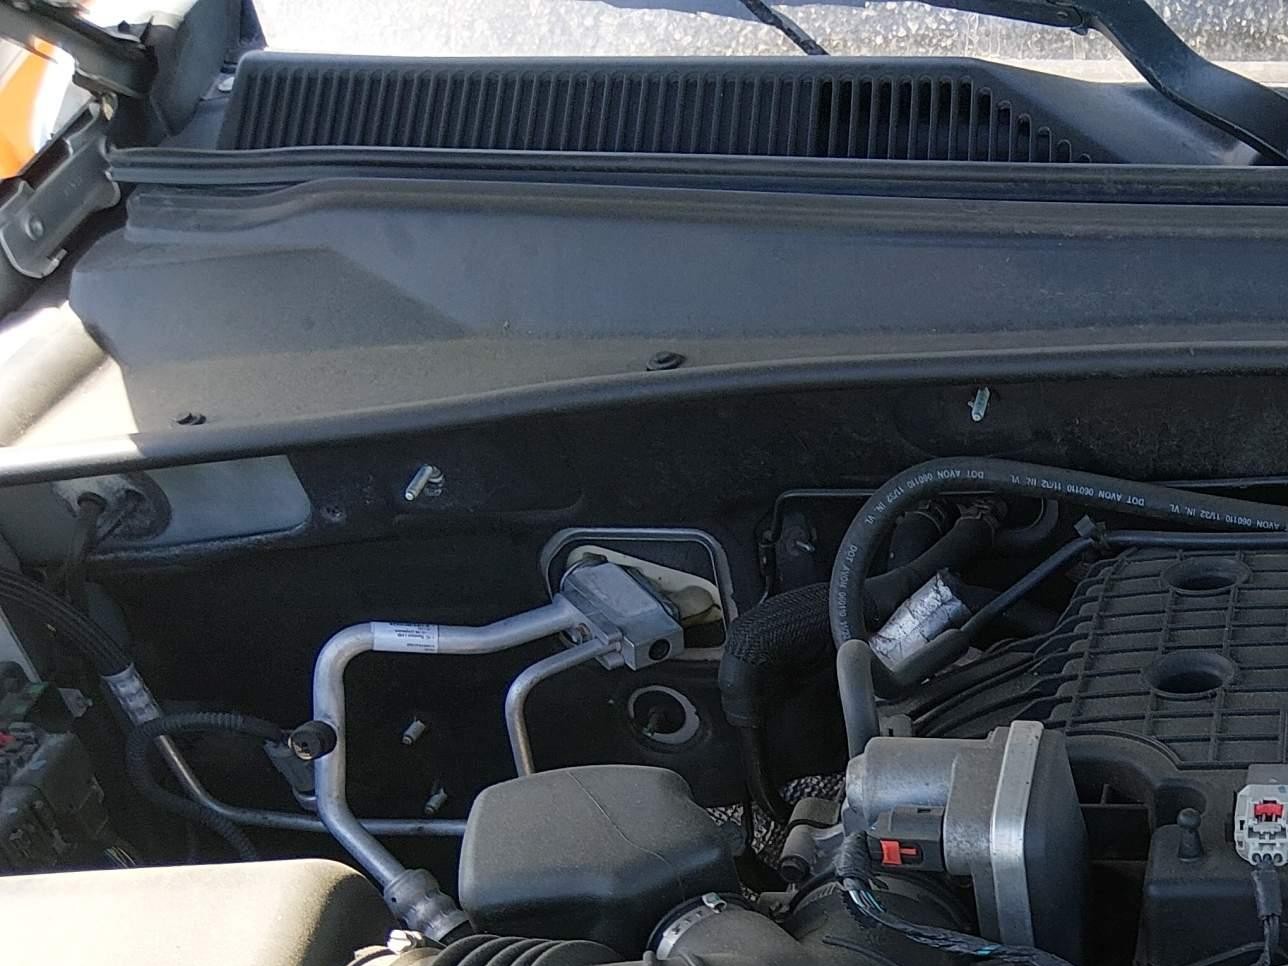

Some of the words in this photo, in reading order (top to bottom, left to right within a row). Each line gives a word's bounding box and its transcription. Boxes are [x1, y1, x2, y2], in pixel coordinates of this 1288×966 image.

[937, 470, 961, 480] AVON
[966, 470, 984, 479] DOT
[1010, 474, 1021, 484] VL
[1066, 485, 1094, 498] 060110
[1098, 490, 1122, 502] AVON
[1127, 497, 1145, 506] DOT
[1168, 503, 1180, 515] VL
[1183, 505, 1197, 517] IN.
[1198, 509, 1221, 521] 11/32
[1225, 513, 1252, 526] 060110
[1255, 519, 1280, 530] AVON
